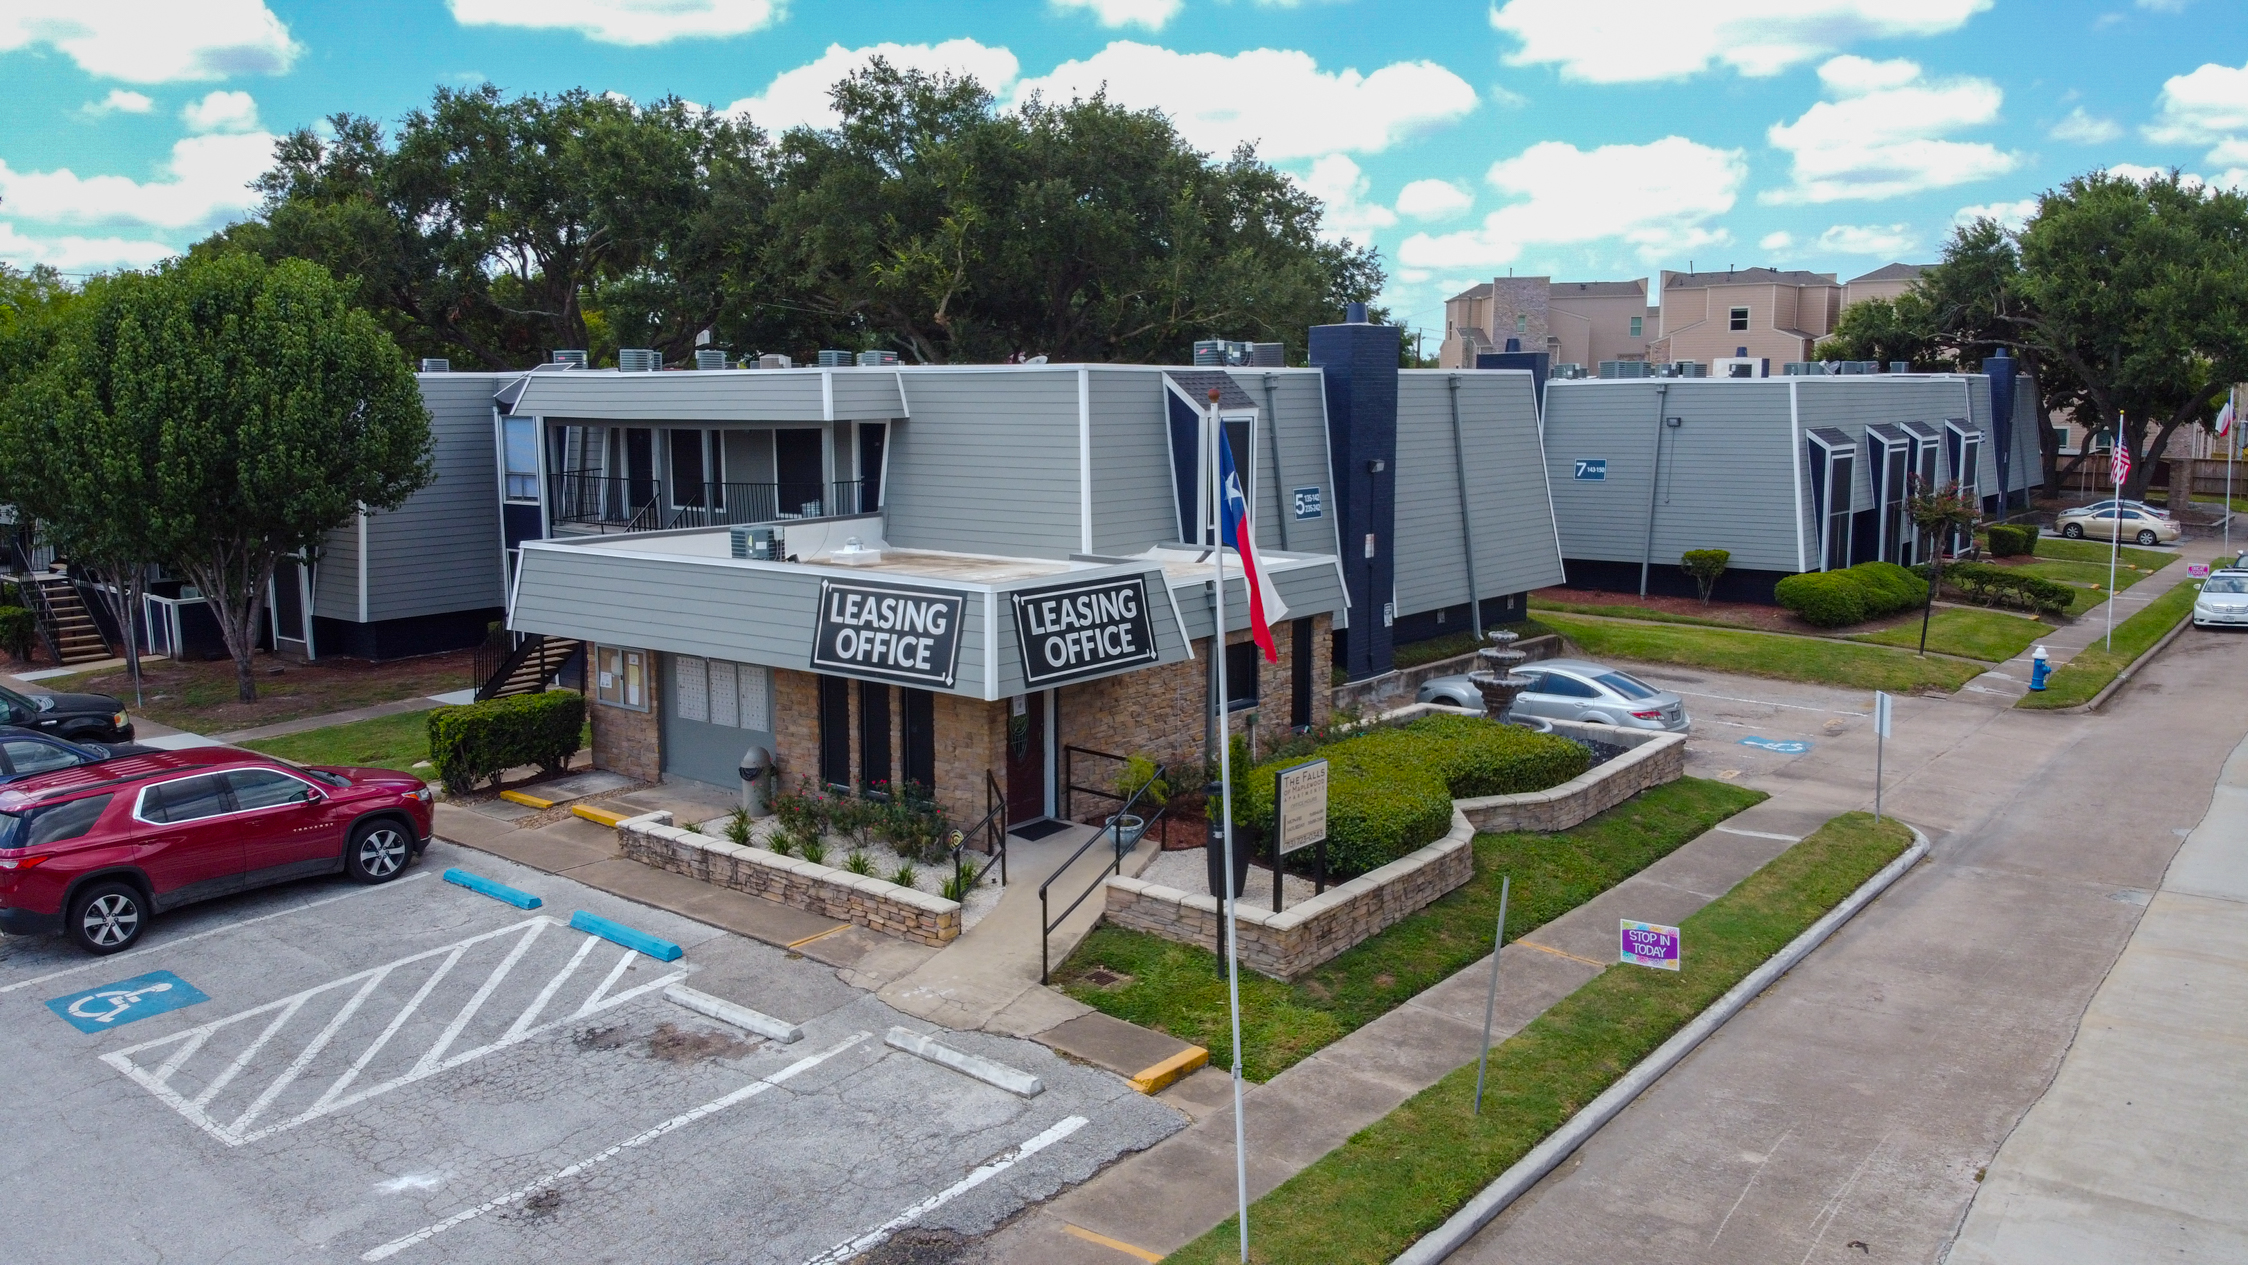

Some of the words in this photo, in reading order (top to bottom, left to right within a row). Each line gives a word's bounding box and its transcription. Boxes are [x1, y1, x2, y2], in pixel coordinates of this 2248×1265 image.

[1576, 462, 1587, 477] 7
[1295, 493, 1305, 515] 5
[830, 592, 947, 636] LEASING
[1027, 588, 1137, 636] LEASING
[835, 628, 934, 670] OFFICE
[1044, 622, 1136, 668] OFFICE
[1284, 776, 1300, 788] THE
[1303, 768, 1325, 782] FALLS
[1292, 778, 1324, 793] MAPLEWOOD
[1284, 785, 1324, 802] APARTMENTS
[1629, 930, 1657, 944] STOP
[1660, 935, 1671, 946] IN
[1632, 942, 1667, 958] TODAY
